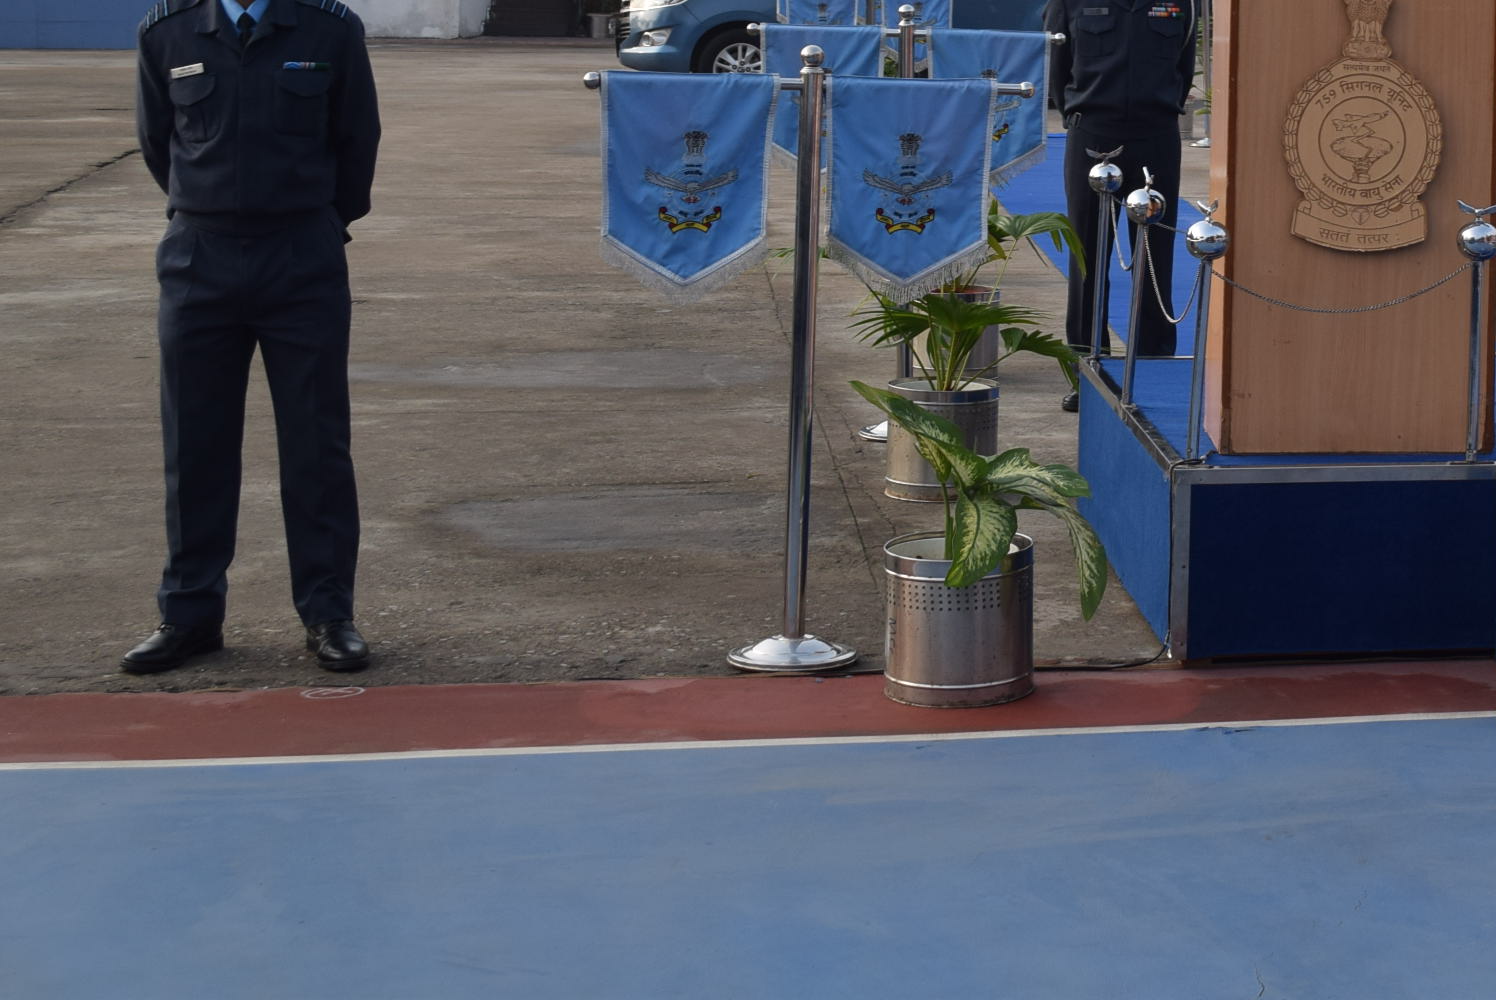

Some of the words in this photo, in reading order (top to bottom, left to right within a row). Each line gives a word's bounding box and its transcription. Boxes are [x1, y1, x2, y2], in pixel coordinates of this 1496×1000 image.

[1314, 88, 1337, 110] 759
[1387, 87, 1413, 112] यूनिट
[1321, 173, 1356, 198] भारतीय
[1359, 187, 1384, 201] वायु
[1381, 174, 1404, 193] सेना
[1319, 227, 1351, 243] सततं
